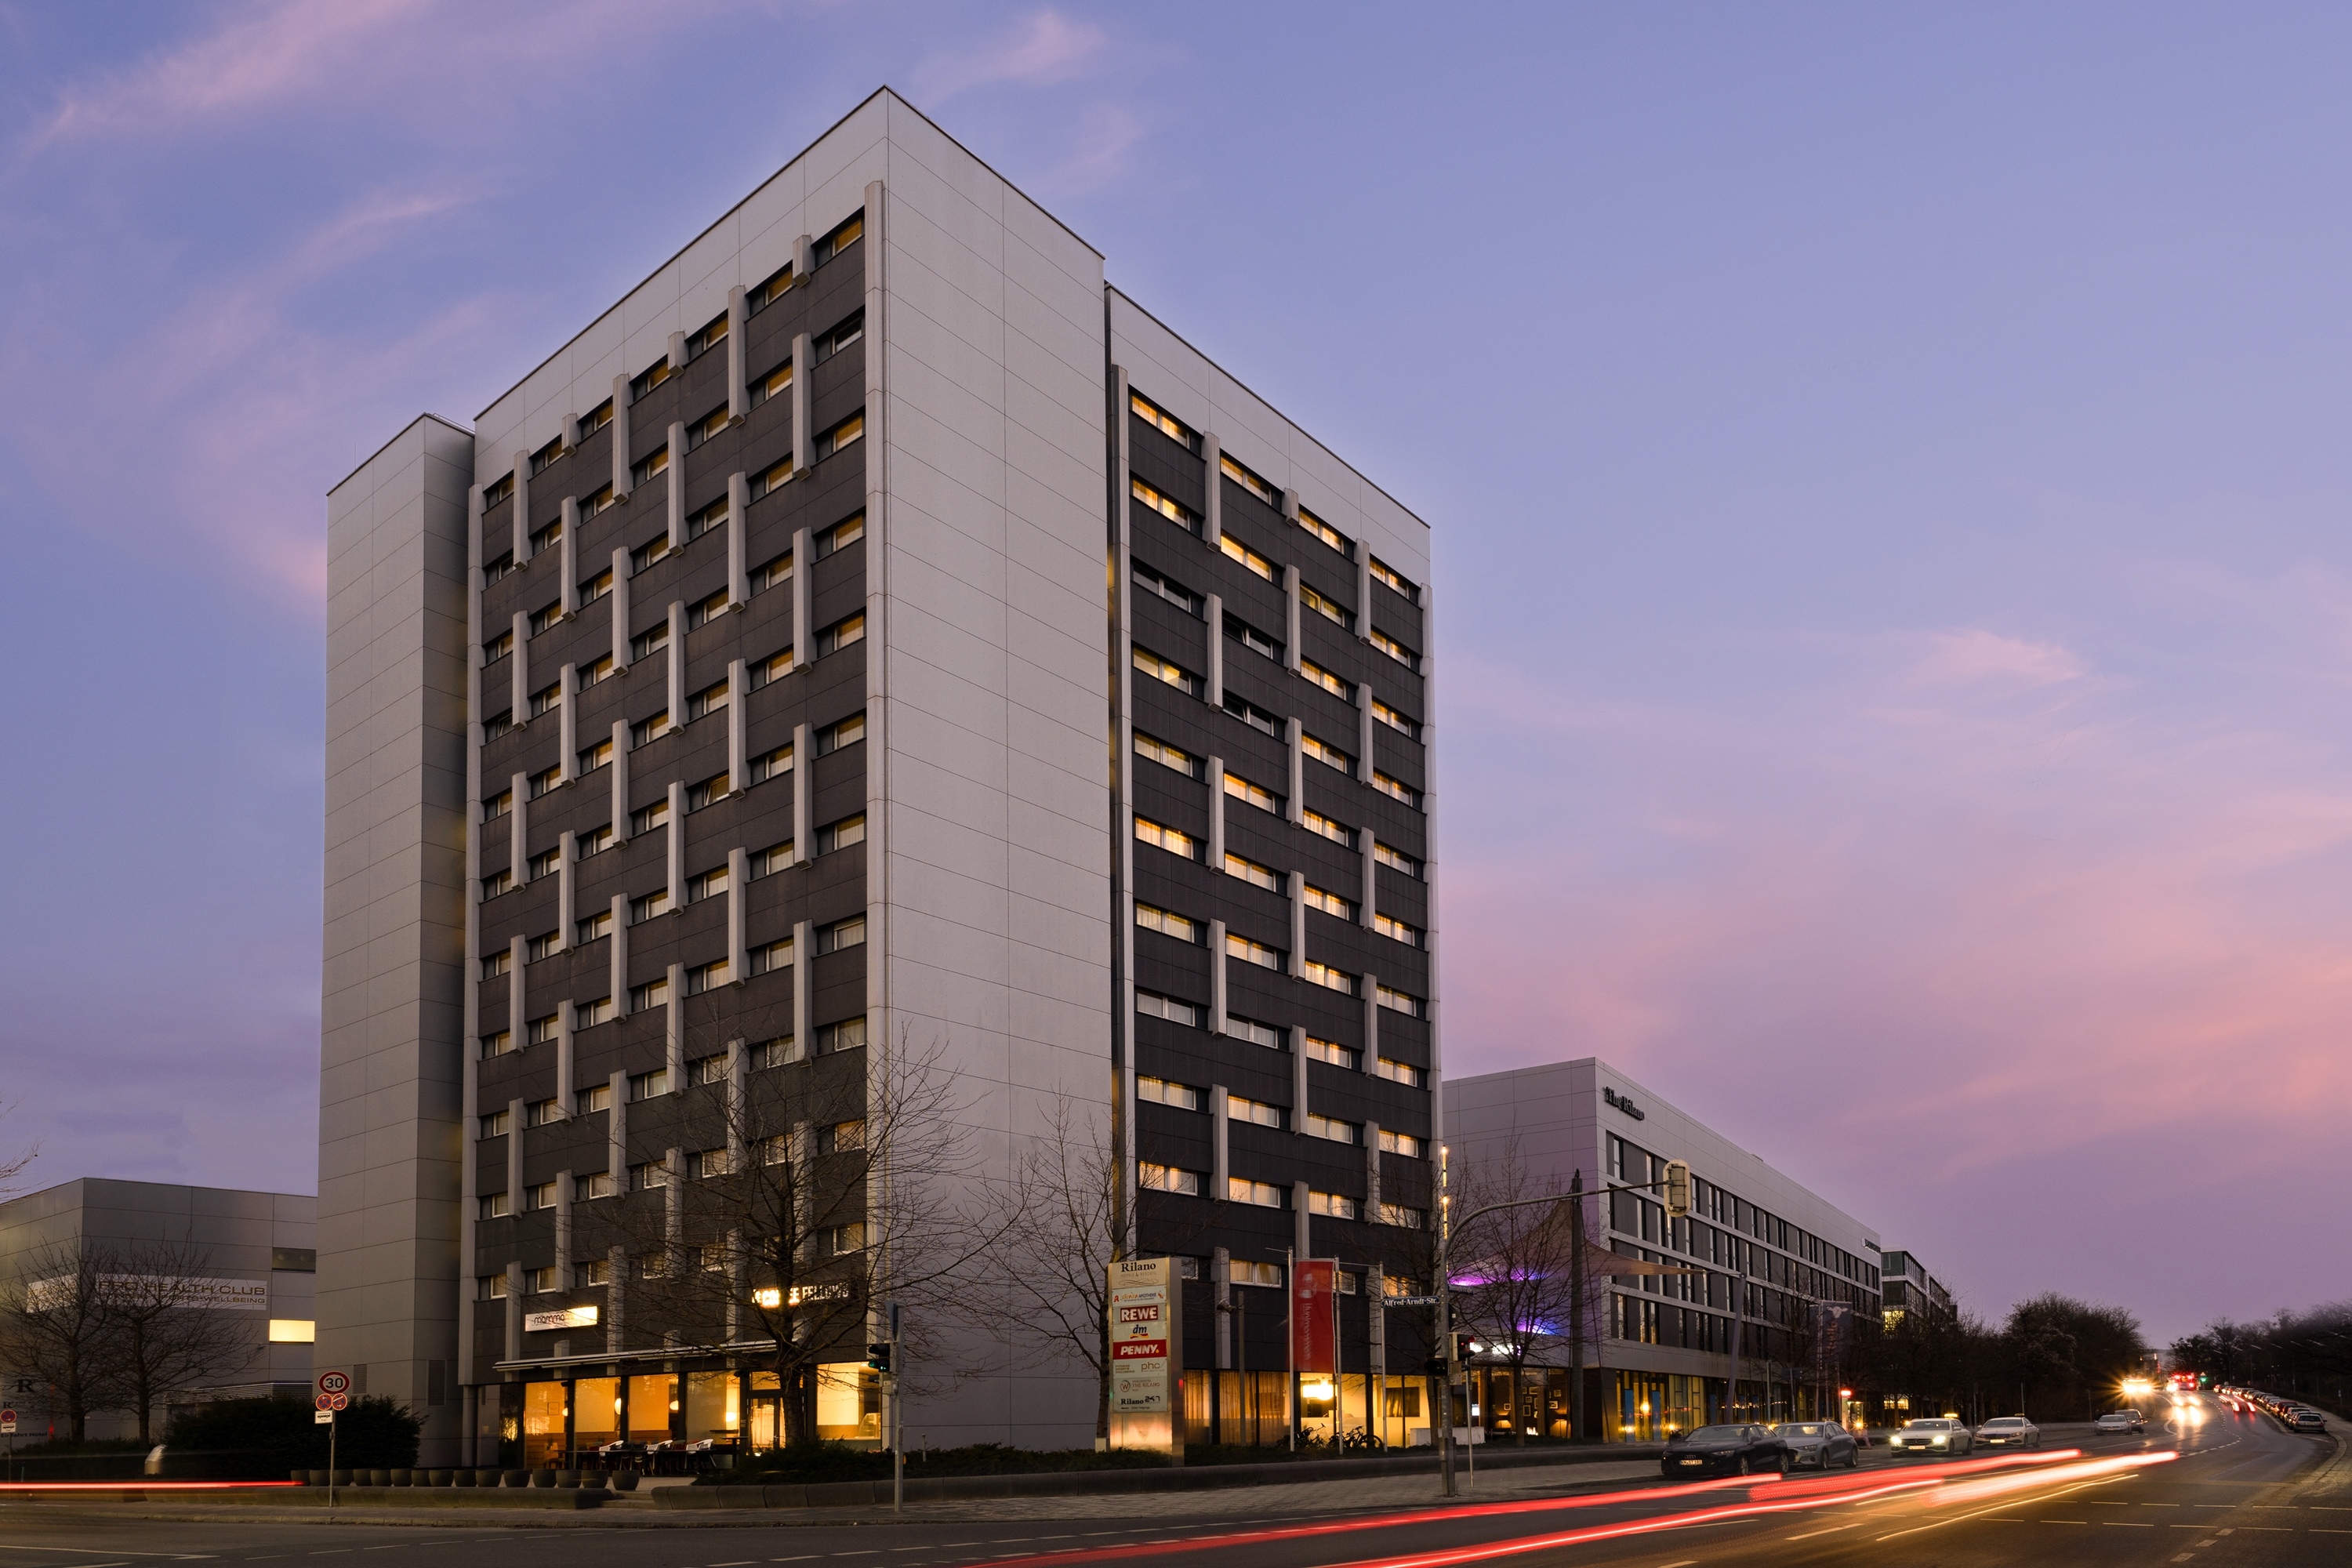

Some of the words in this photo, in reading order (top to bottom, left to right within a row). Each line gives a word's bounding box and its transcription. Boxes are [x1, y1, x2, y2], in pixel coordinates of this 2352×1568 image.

[1121, 1262, 1156, 1272] Rilano
[220, 1286, 266, 1296] CLUB
[1384, 1298, 1438, 1307] Alfred-Arndt-Str.
[1120, 1307, 1157, 1322] REWE
[1132, 1324, 1148, 1334] dm
[1141, 1361, 1160, 1372] phc
[325, 1377, 343, 1388] 30
